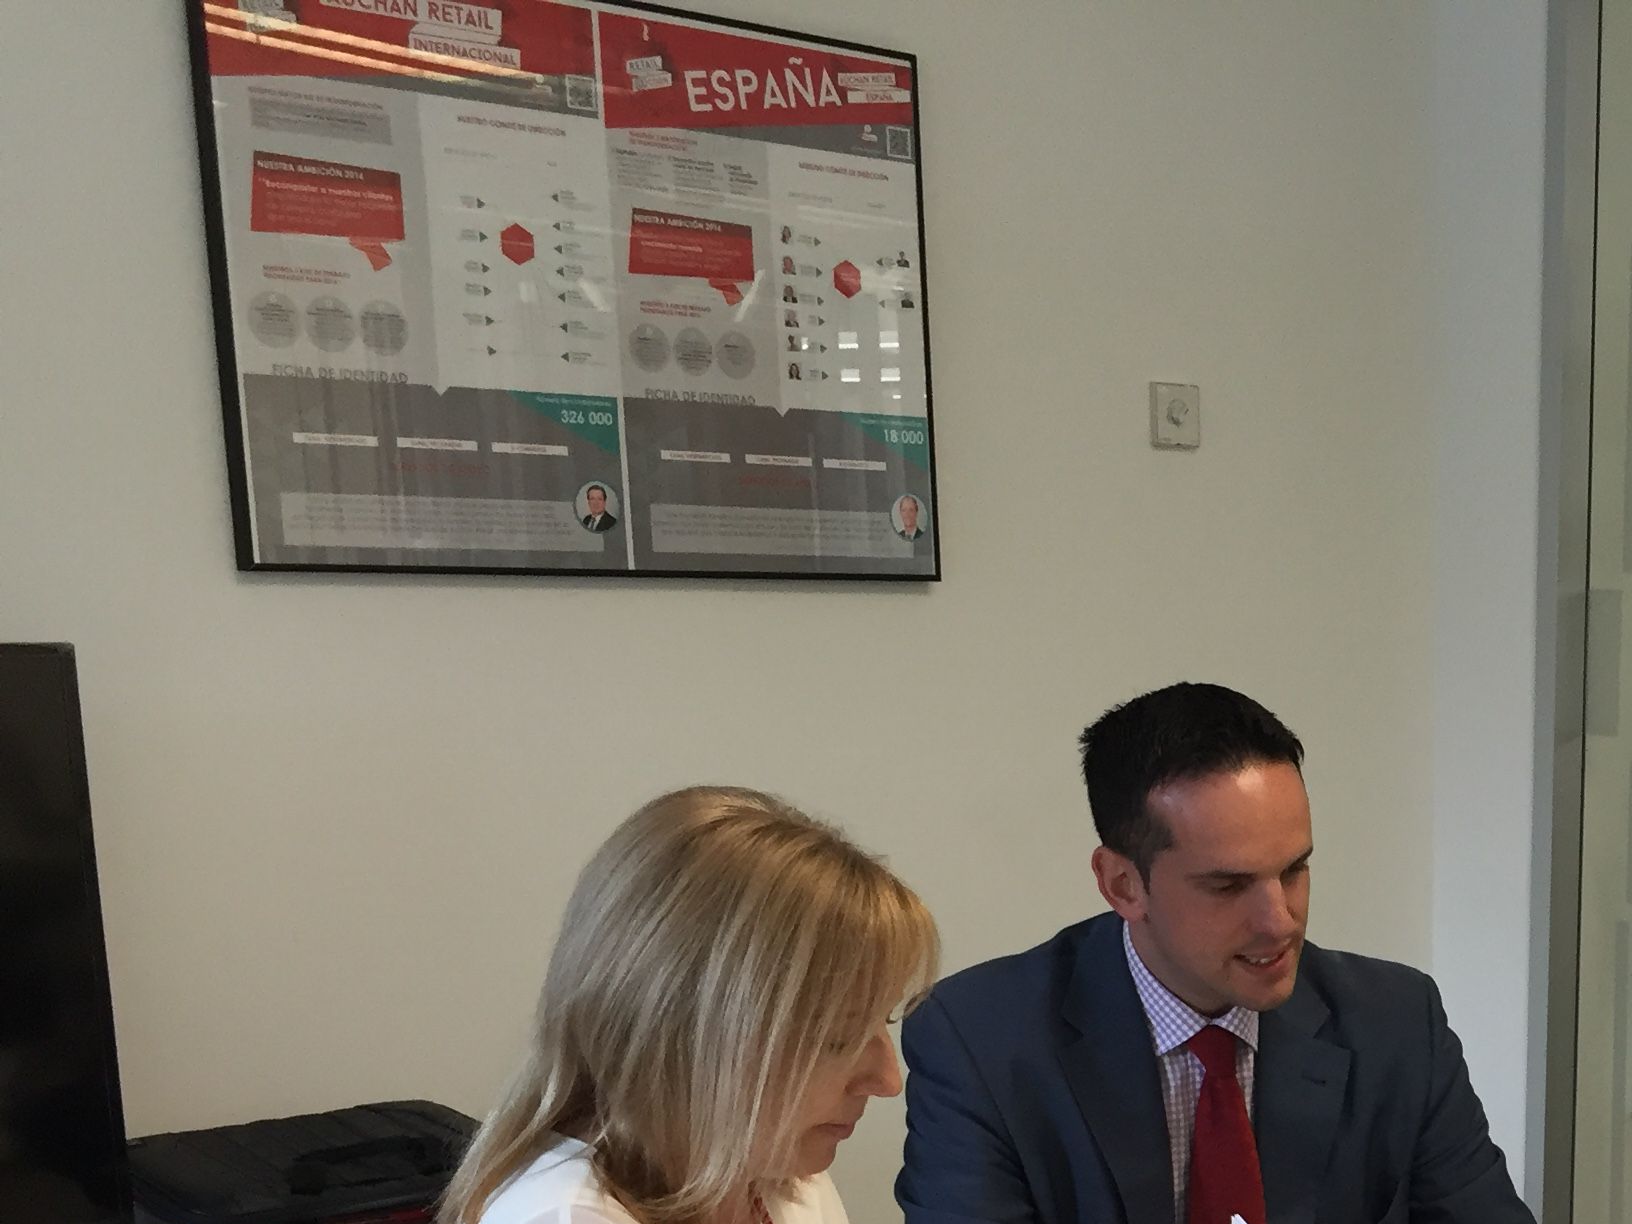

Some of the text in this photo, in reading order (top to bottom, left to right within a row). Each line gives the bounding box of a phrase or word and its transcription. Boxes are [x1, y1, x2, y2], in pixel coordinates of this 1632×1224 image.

[428, 0, 494, 30] RETAIL
[413, 37, 518, 66] INTERNACIONAL
[684, 56, 843, 112] ESPAÑA
[561, 410, 613, 426] 326 000
[884, 429, 924, 445] 18 000
